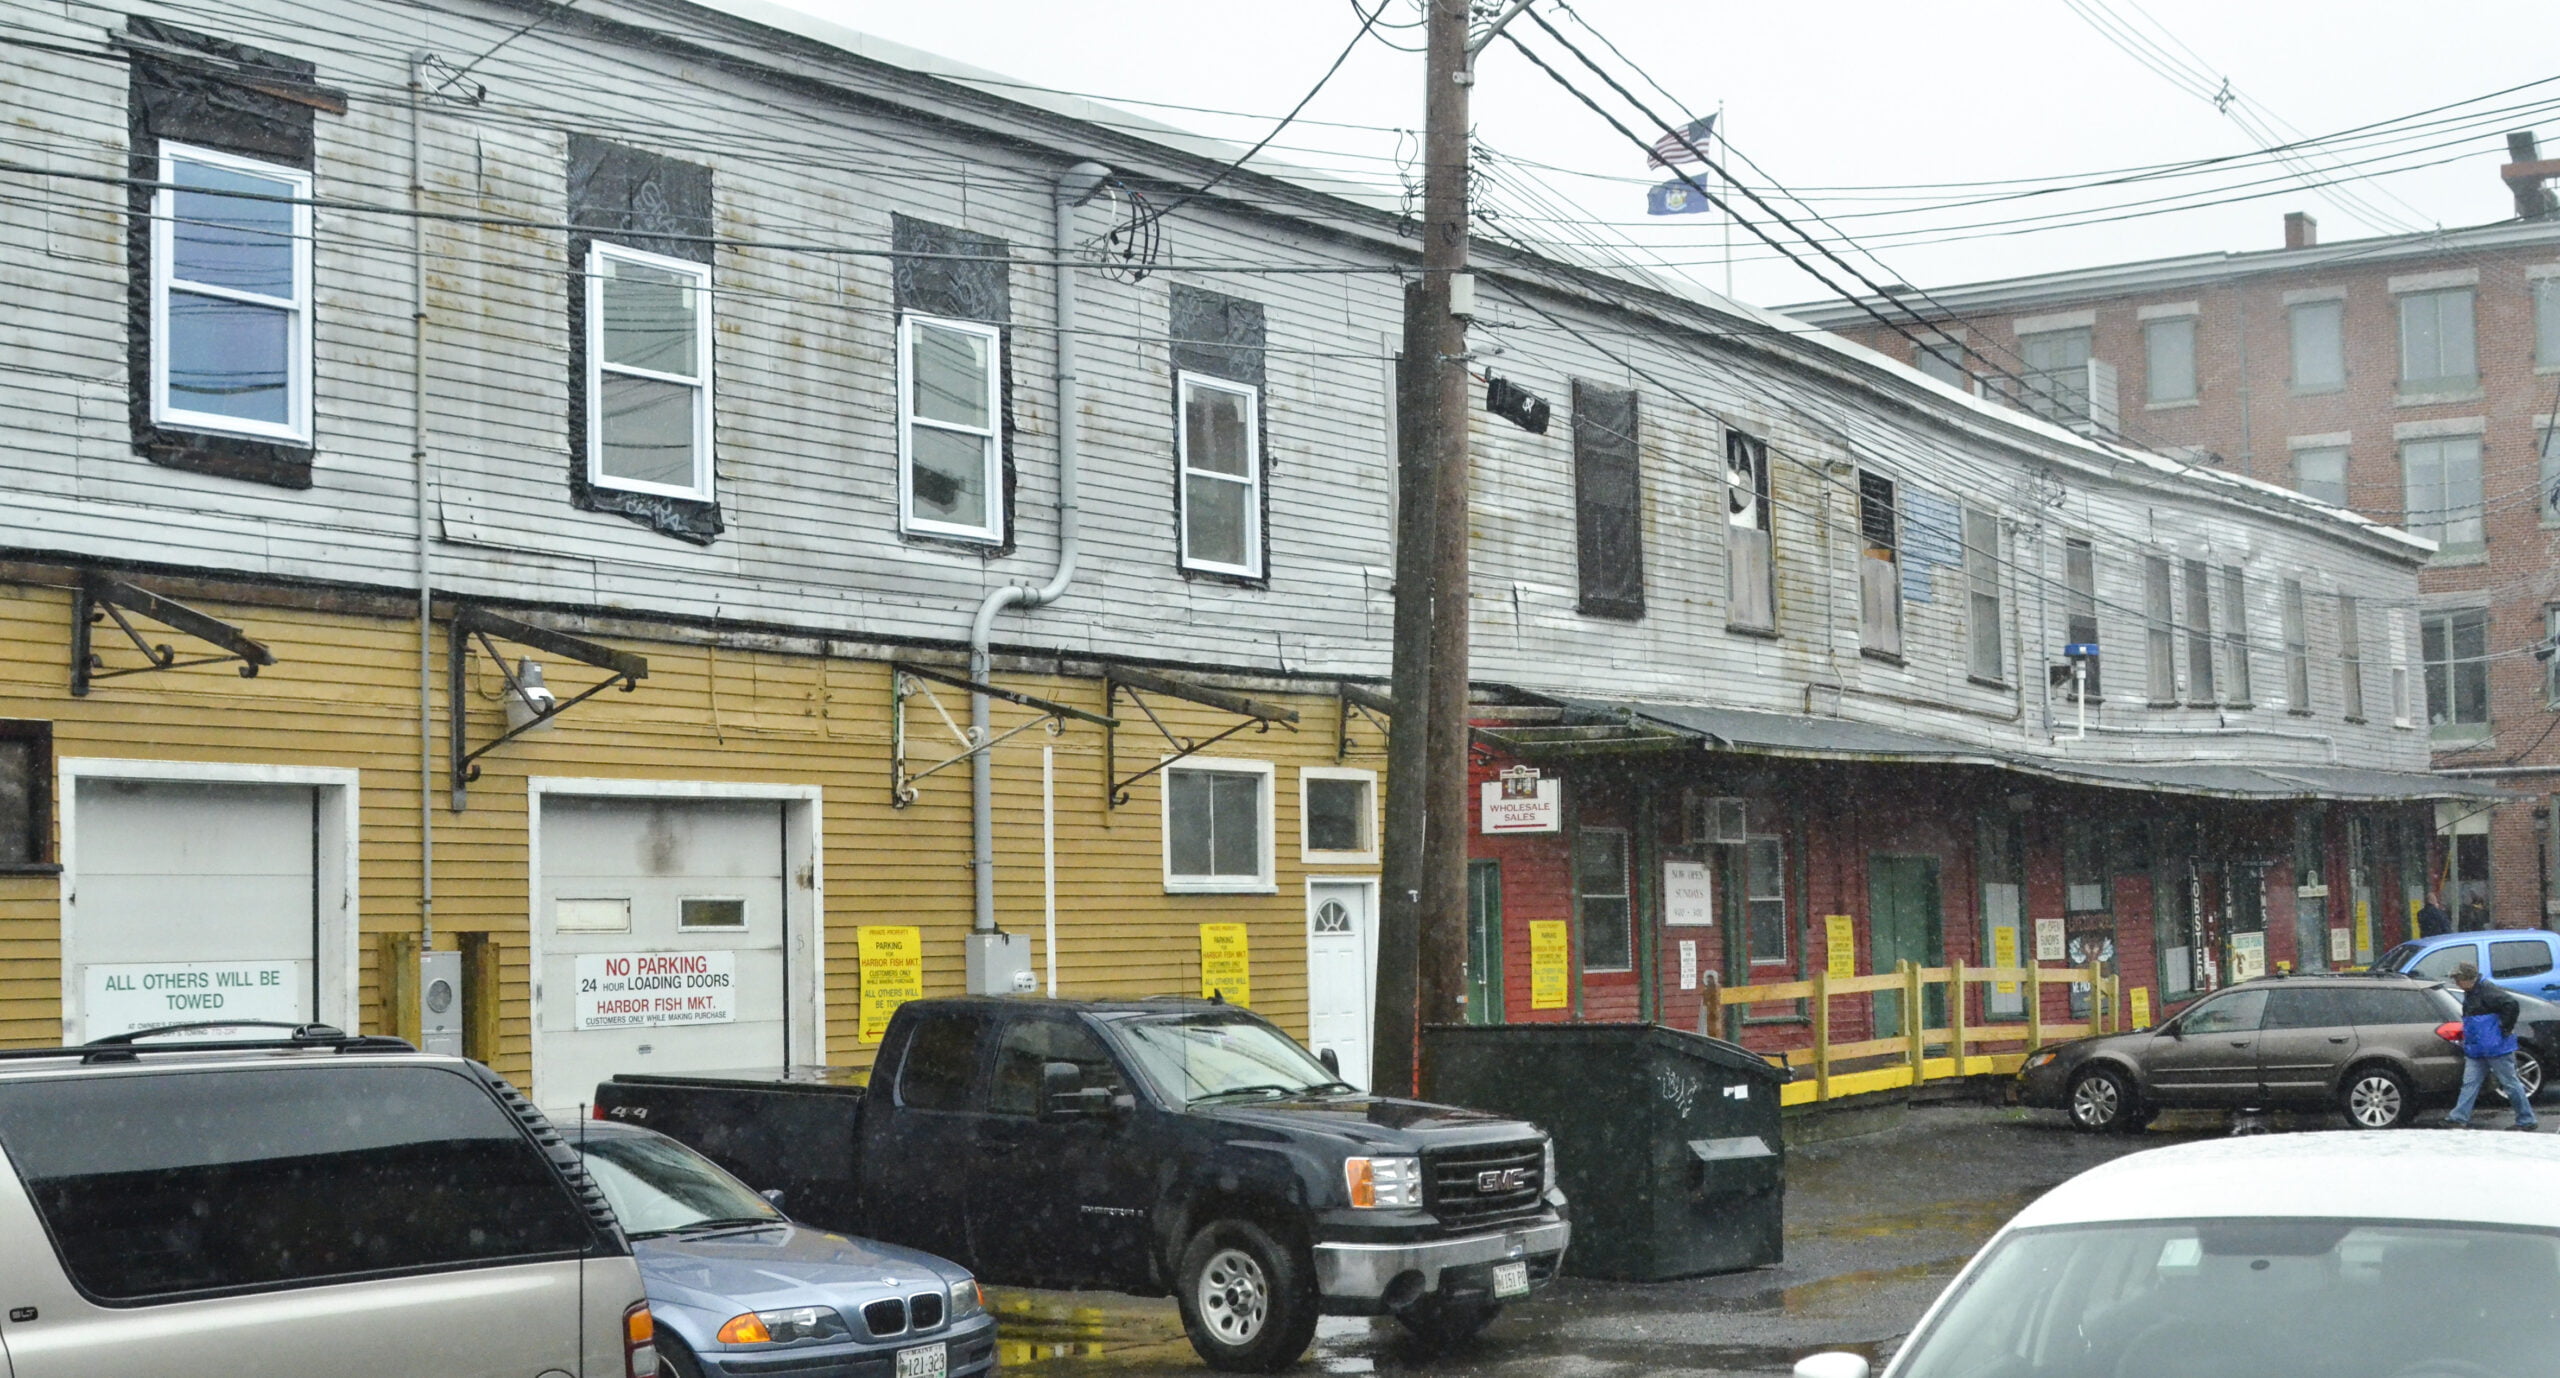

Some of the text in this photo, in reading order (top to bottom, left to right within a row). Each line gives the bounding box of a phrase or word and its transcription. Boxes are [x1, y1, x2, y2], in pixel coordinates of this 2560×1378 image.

[1490, 802, 1550, 812] WHOLESALE
[1504, 813, 1535, 822] SALES
[1688, 870, 1704, 880] OPEN
[1675, 888, 1704, 898] SUNDAYS
[2192, 866, 2204, 981] LOBSTER
[876, 942, 902, 950] PARKING
[606, 956, 707, 976] NO PARKING
[862, 959, 888, 967] HARBOR
[890, 958, 904, 966] FISH
[105, 970, 280, 991] ALL OTHERS WILL BE
[582, 974, 730, 992] 24 HOUR LOADING DOORS
[878, 989, 902, 997] OTHERS
[905, 988, 919, 996] WILL
[166, 994, 224, 1010] TOWED
[597, 996, 716, 1014] HARBOR FISH MKT.
[586, 1016, 626, 1025] CUSTOMERS
[629, 1015, 644, 1024] ONLY
[1478, 1168, 1524, 1192] GMC
